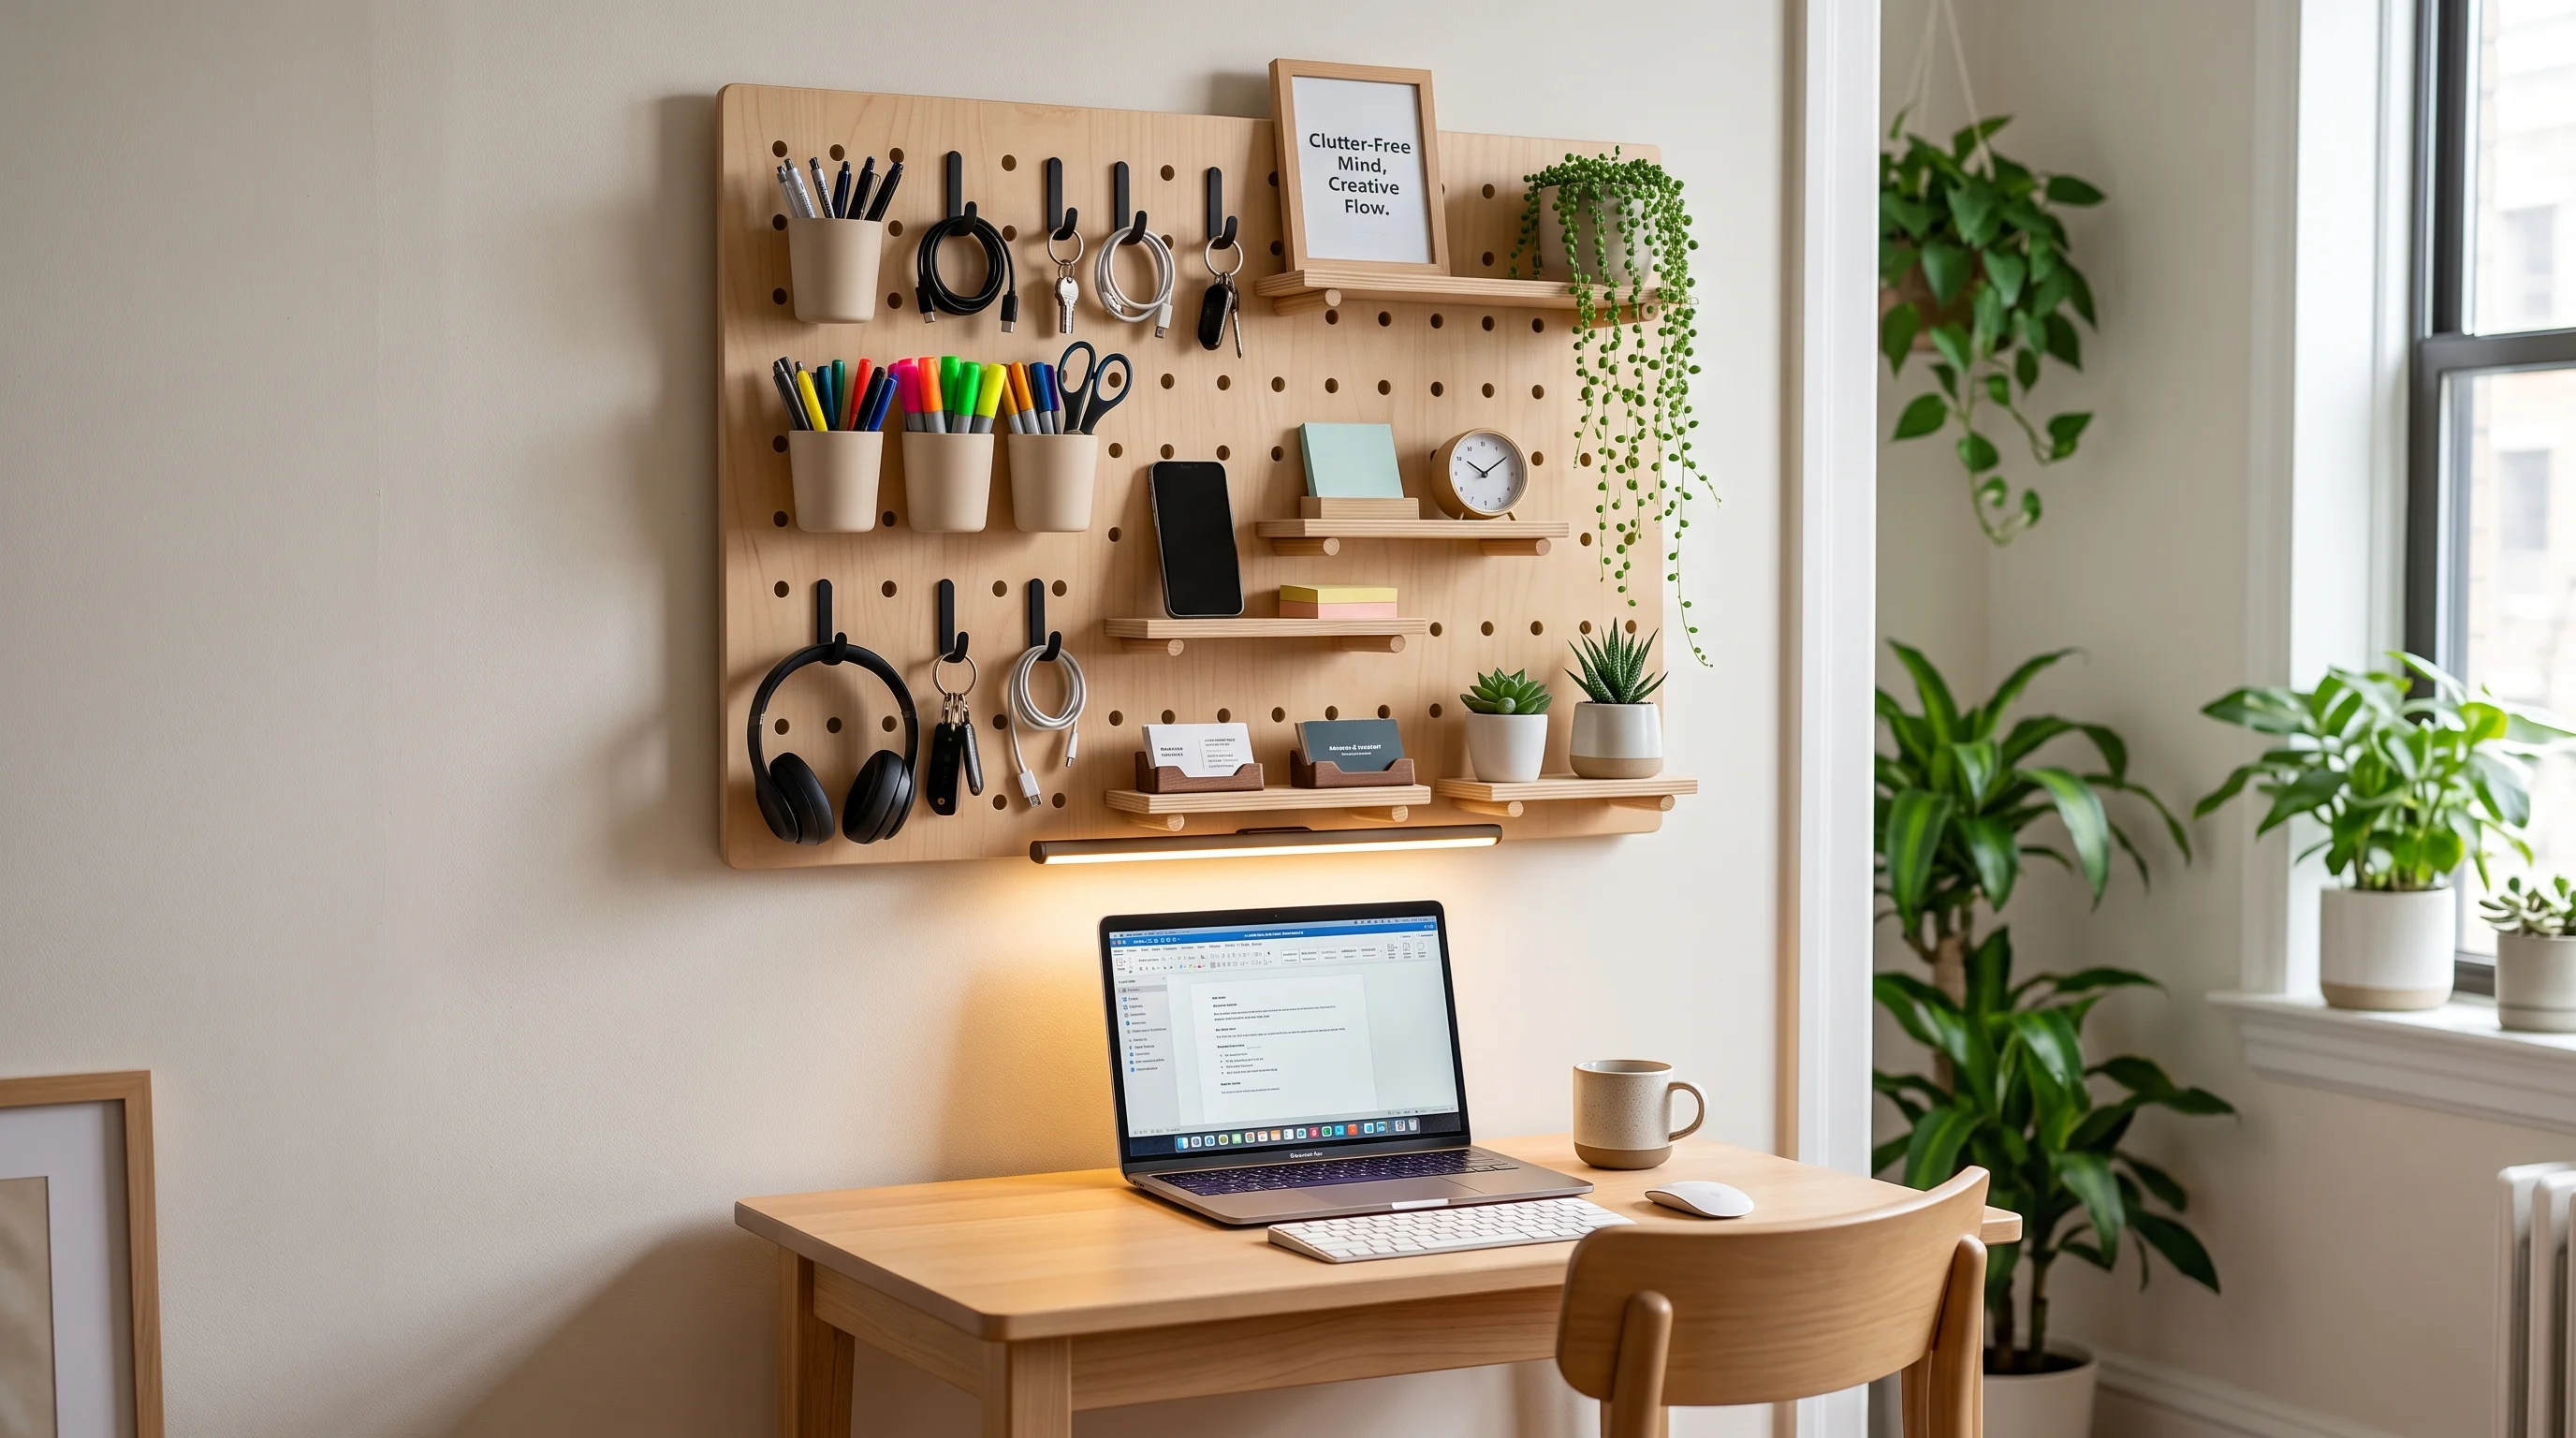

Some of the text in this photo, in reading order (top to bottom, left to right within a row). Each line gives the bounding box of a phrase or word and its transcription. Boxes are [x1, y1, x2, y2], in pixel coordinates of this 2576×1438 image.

[1309, 133, 1411, 154] Clutter-Free
[1338, 155, 1386, 175] Mind,
[1328, 176, 1399, 195] Creative
[1344, 198, 1390, 215] Flow.
